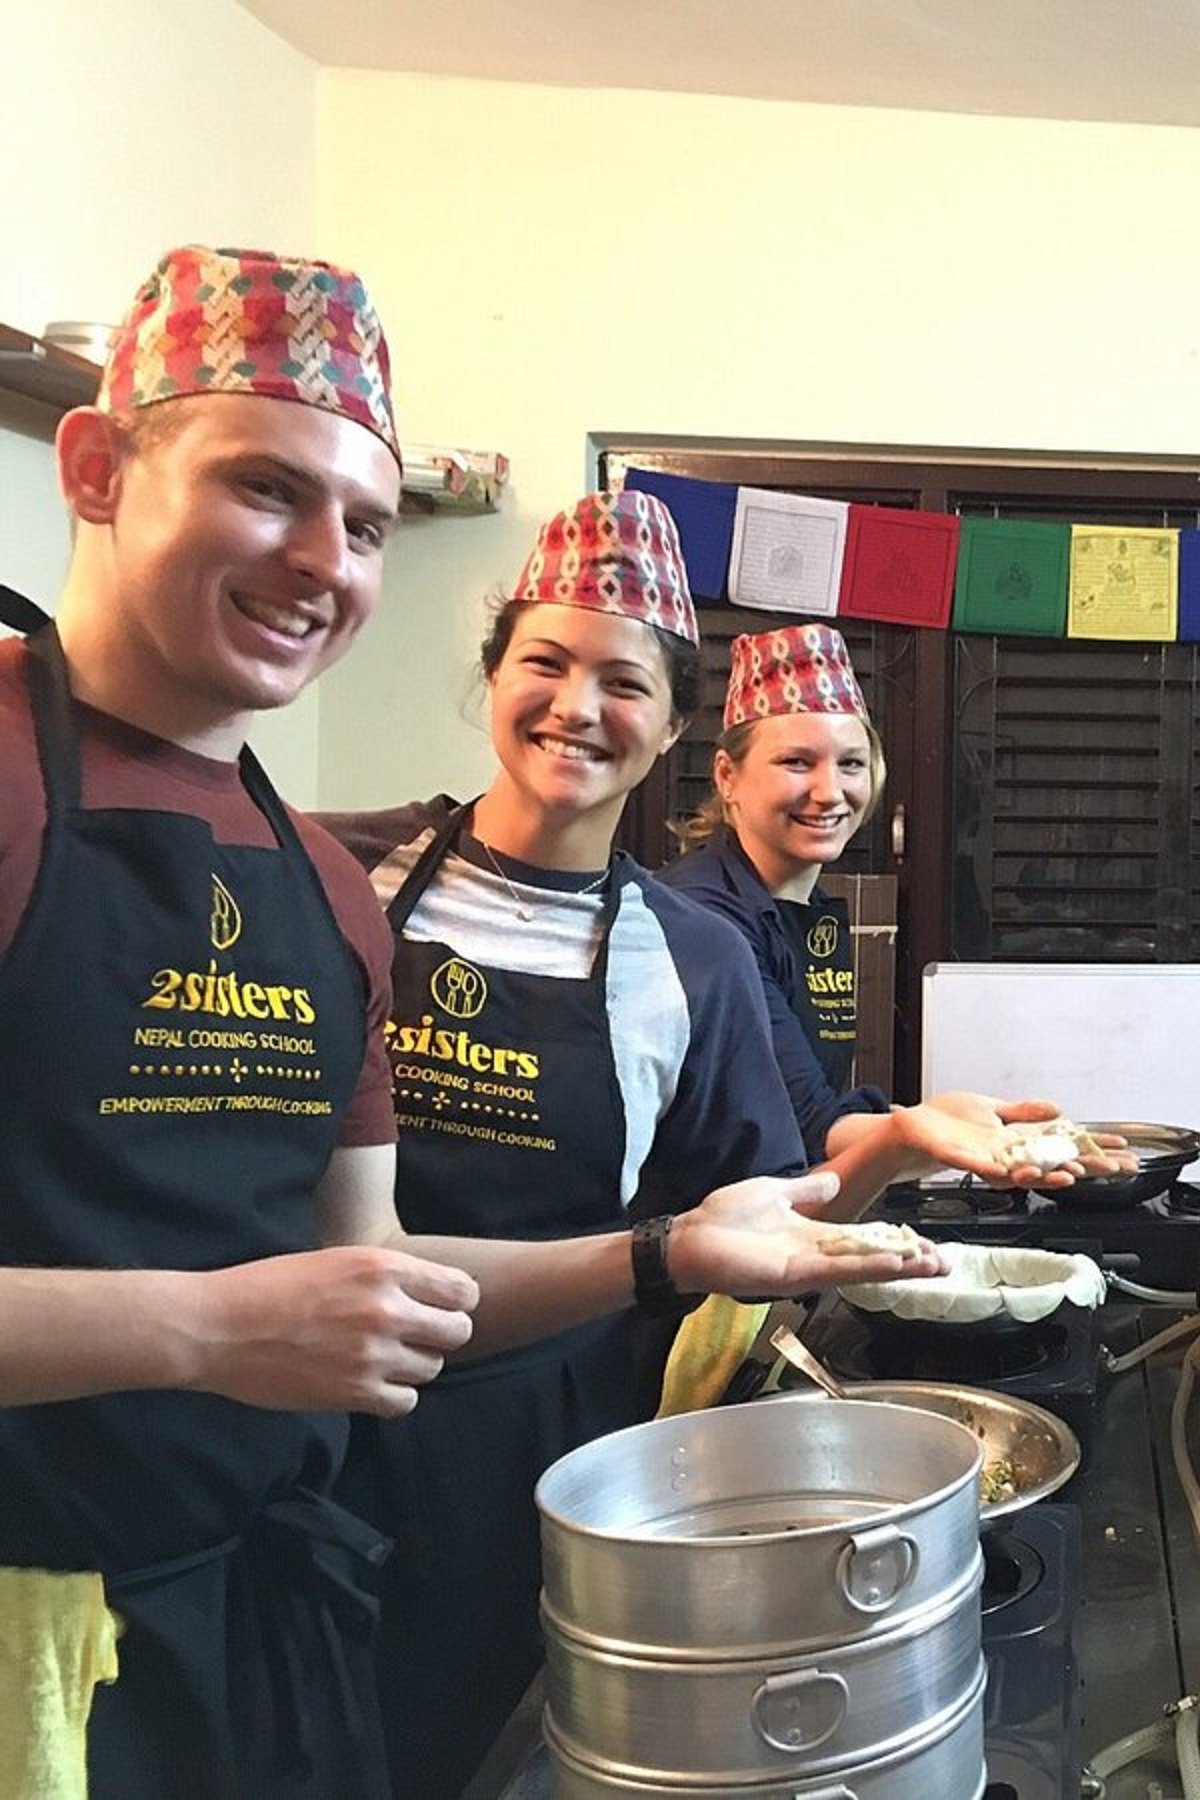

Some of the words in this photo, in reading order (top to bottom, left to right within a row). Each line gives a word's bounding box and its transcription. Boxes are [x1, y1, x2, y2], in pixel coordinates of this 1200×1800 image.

[142, 958, 316, 1025] 2sisters
[134, 1028, 186, 1049] NEPAL
[188, 1029, 257, 1050] COOKING
[259, 1033, 317, 1055] SCHOOL
[395, 1063, 469, 1091] COOKING
[473, 1081, 536, 1103] SCHOOL
[99, 1097, 224, 1115] EMPOWERMENT
[225, 1095, 283, 1112] THROUGH
[282, 1100, 333, 1115] COOKING
[430, 1117, 496, 1141] THROUGH
[498, 1131, 556, 1151] COOKING
